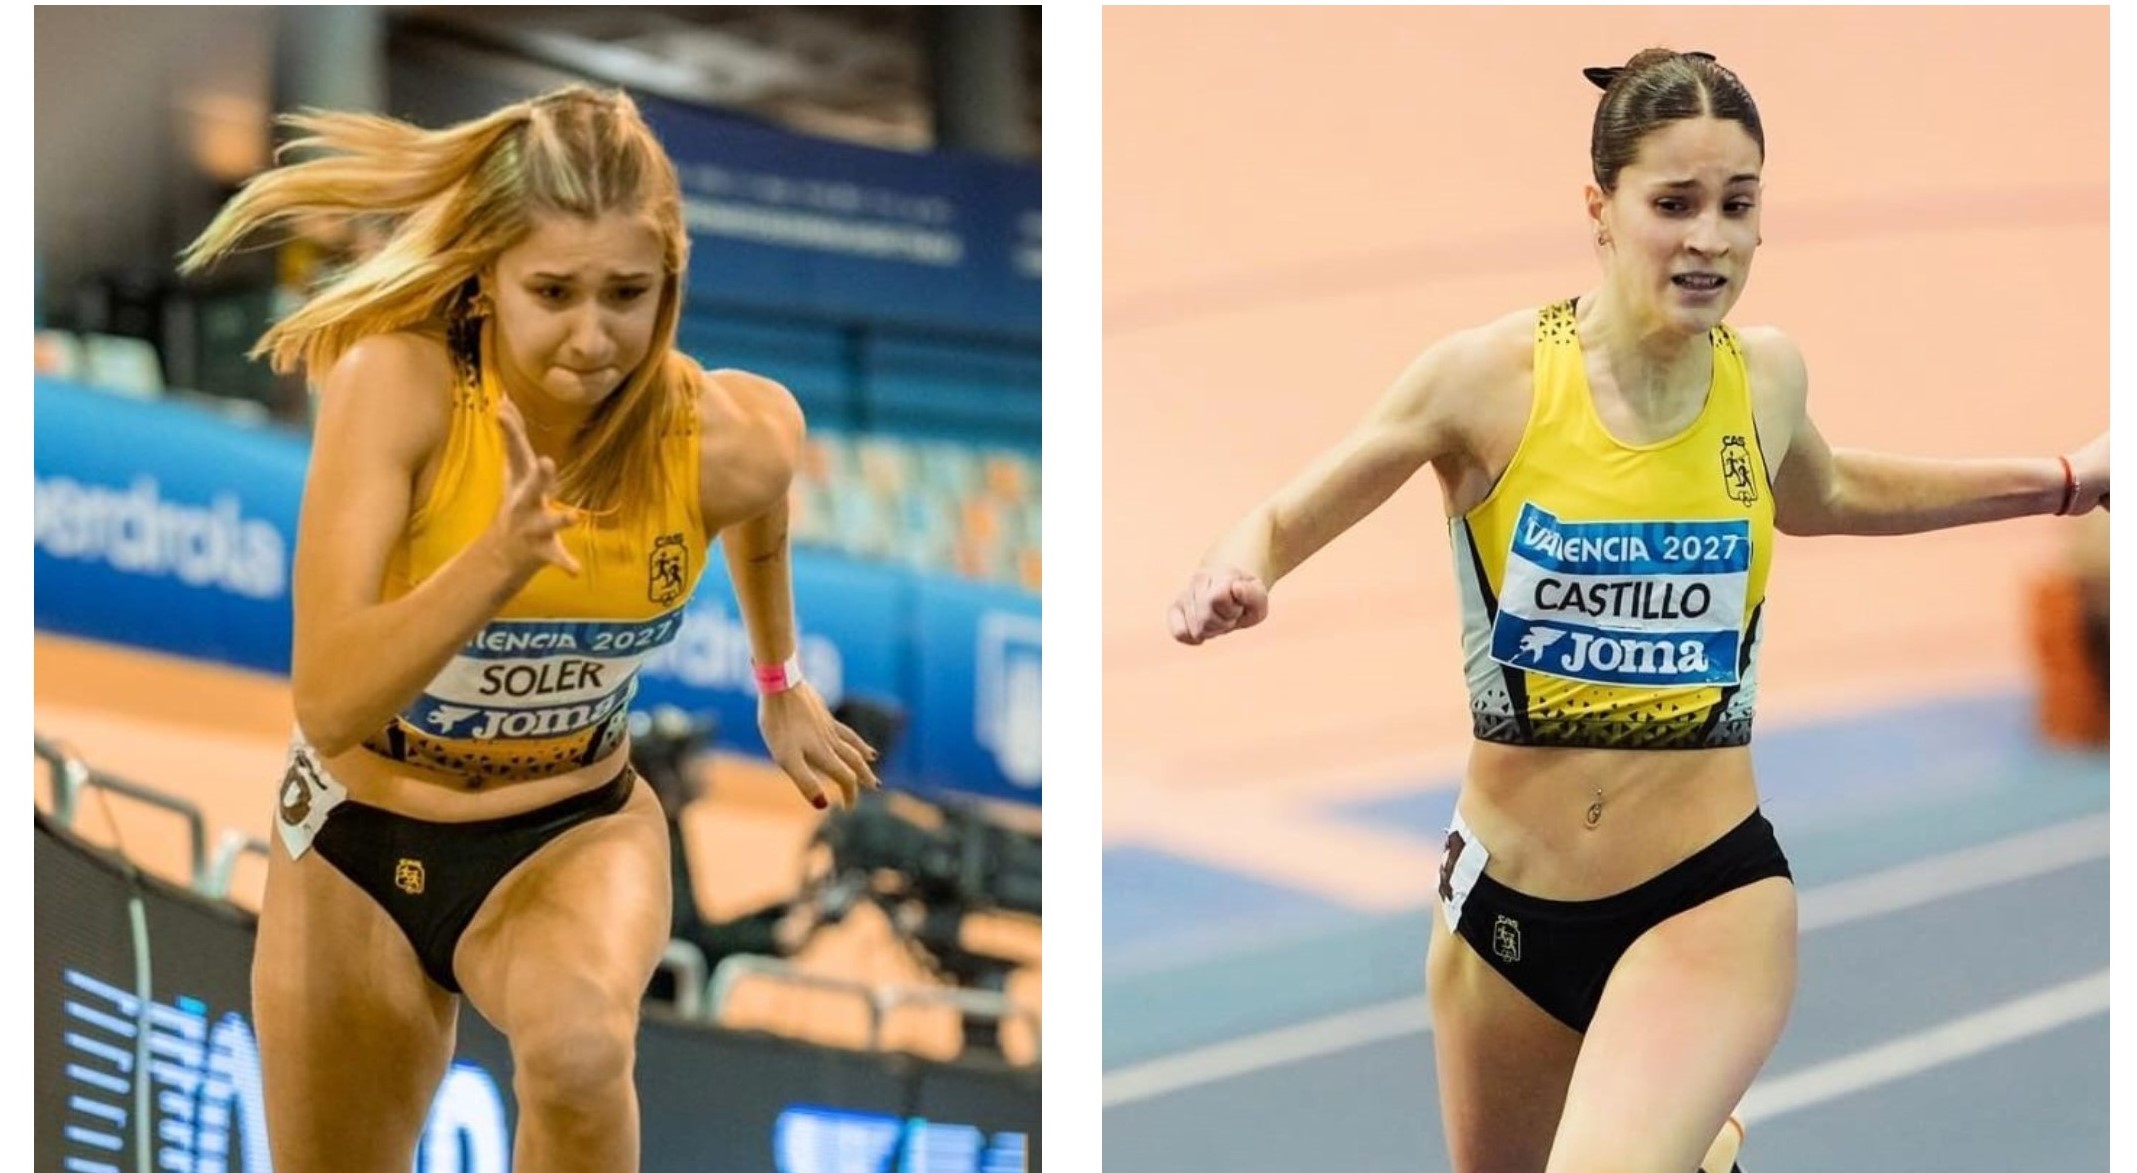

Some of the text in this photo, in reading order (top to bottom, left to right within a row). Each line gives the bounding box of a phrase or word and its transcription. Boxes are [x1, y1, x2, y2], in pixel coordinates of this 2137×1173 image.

[1662, 534, 1740, 561] 2027
[1534, 578, 1711, 619] CASTILLO
[466, 619, 673, 652] LENCIA 2027
[479, 659, 604, 697] SOLER
